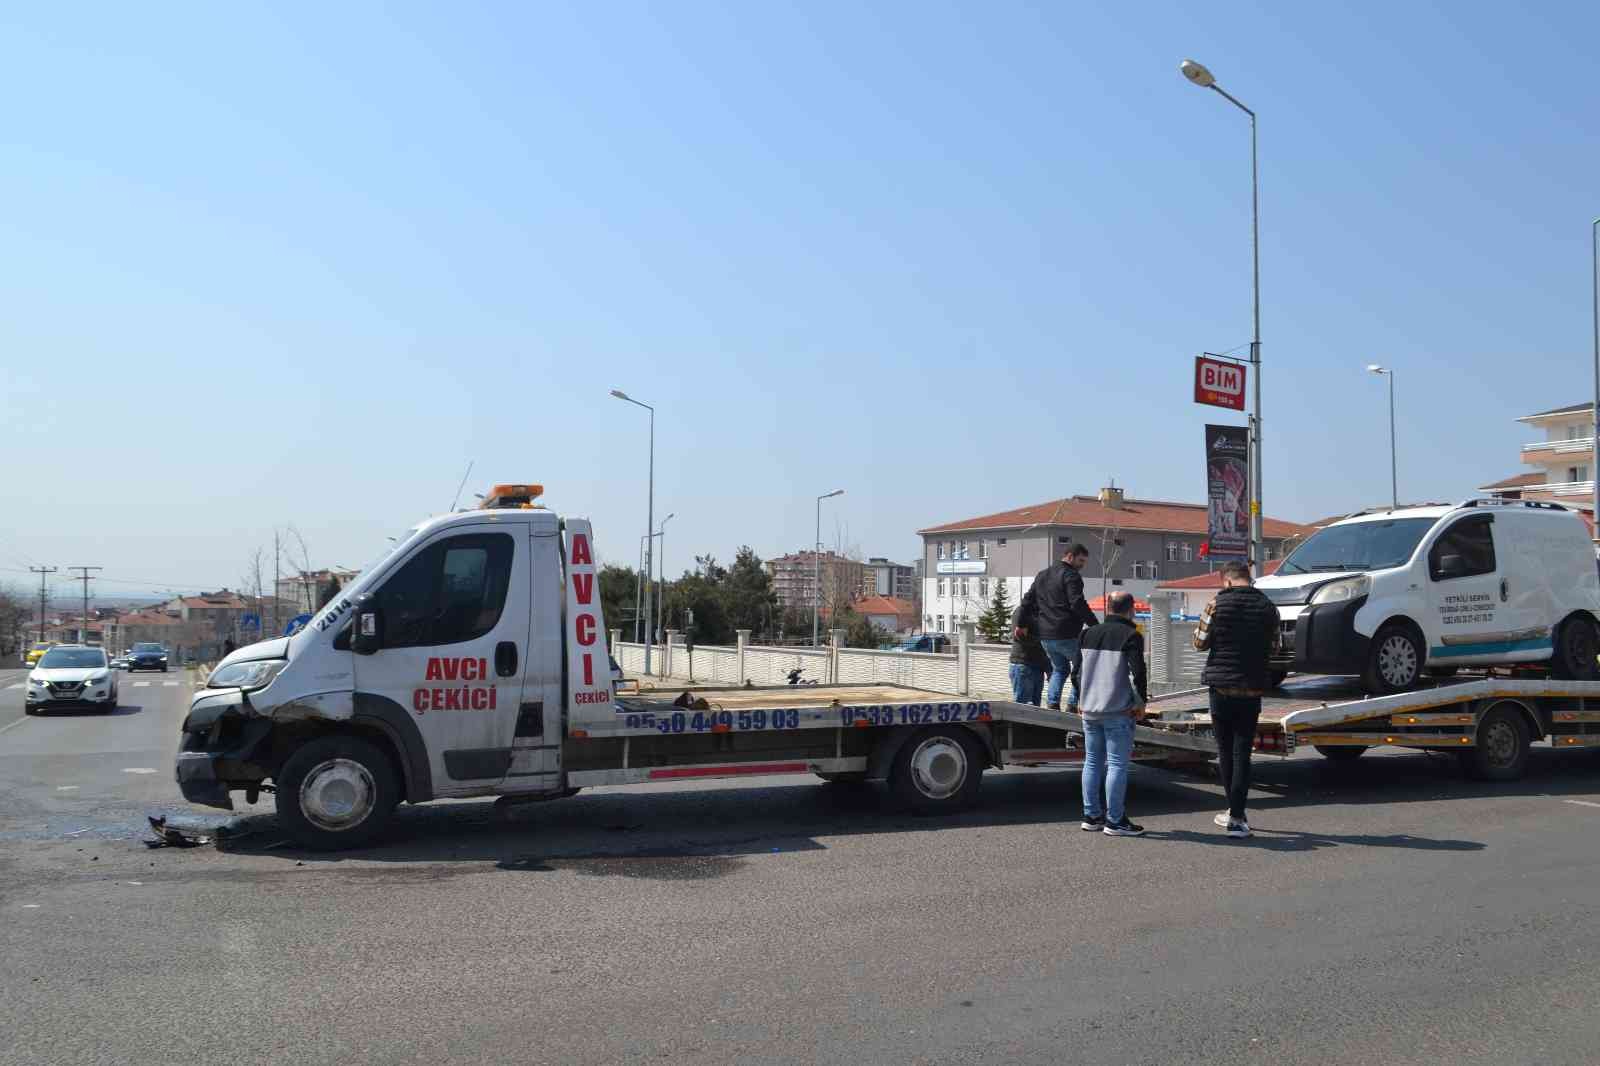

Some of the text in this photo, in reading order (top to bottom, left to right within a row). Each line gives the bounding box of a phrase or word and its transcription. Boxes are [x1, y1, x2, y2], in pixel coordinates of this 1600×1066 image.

[1205, 365, 1237, 390] BİM
[317, 598, 352, 631] 2014
[425, 657, 487, 681] AVCI
[413, 684, 497, 716] ÇEKİCİ
[738, 709, 767, 731] 59
[772, 708, 800, 730] 03
[842, 704, 894, 727] 0533
[898, 704, 934, 724] 162
[938, 703, 963, 722] 52
